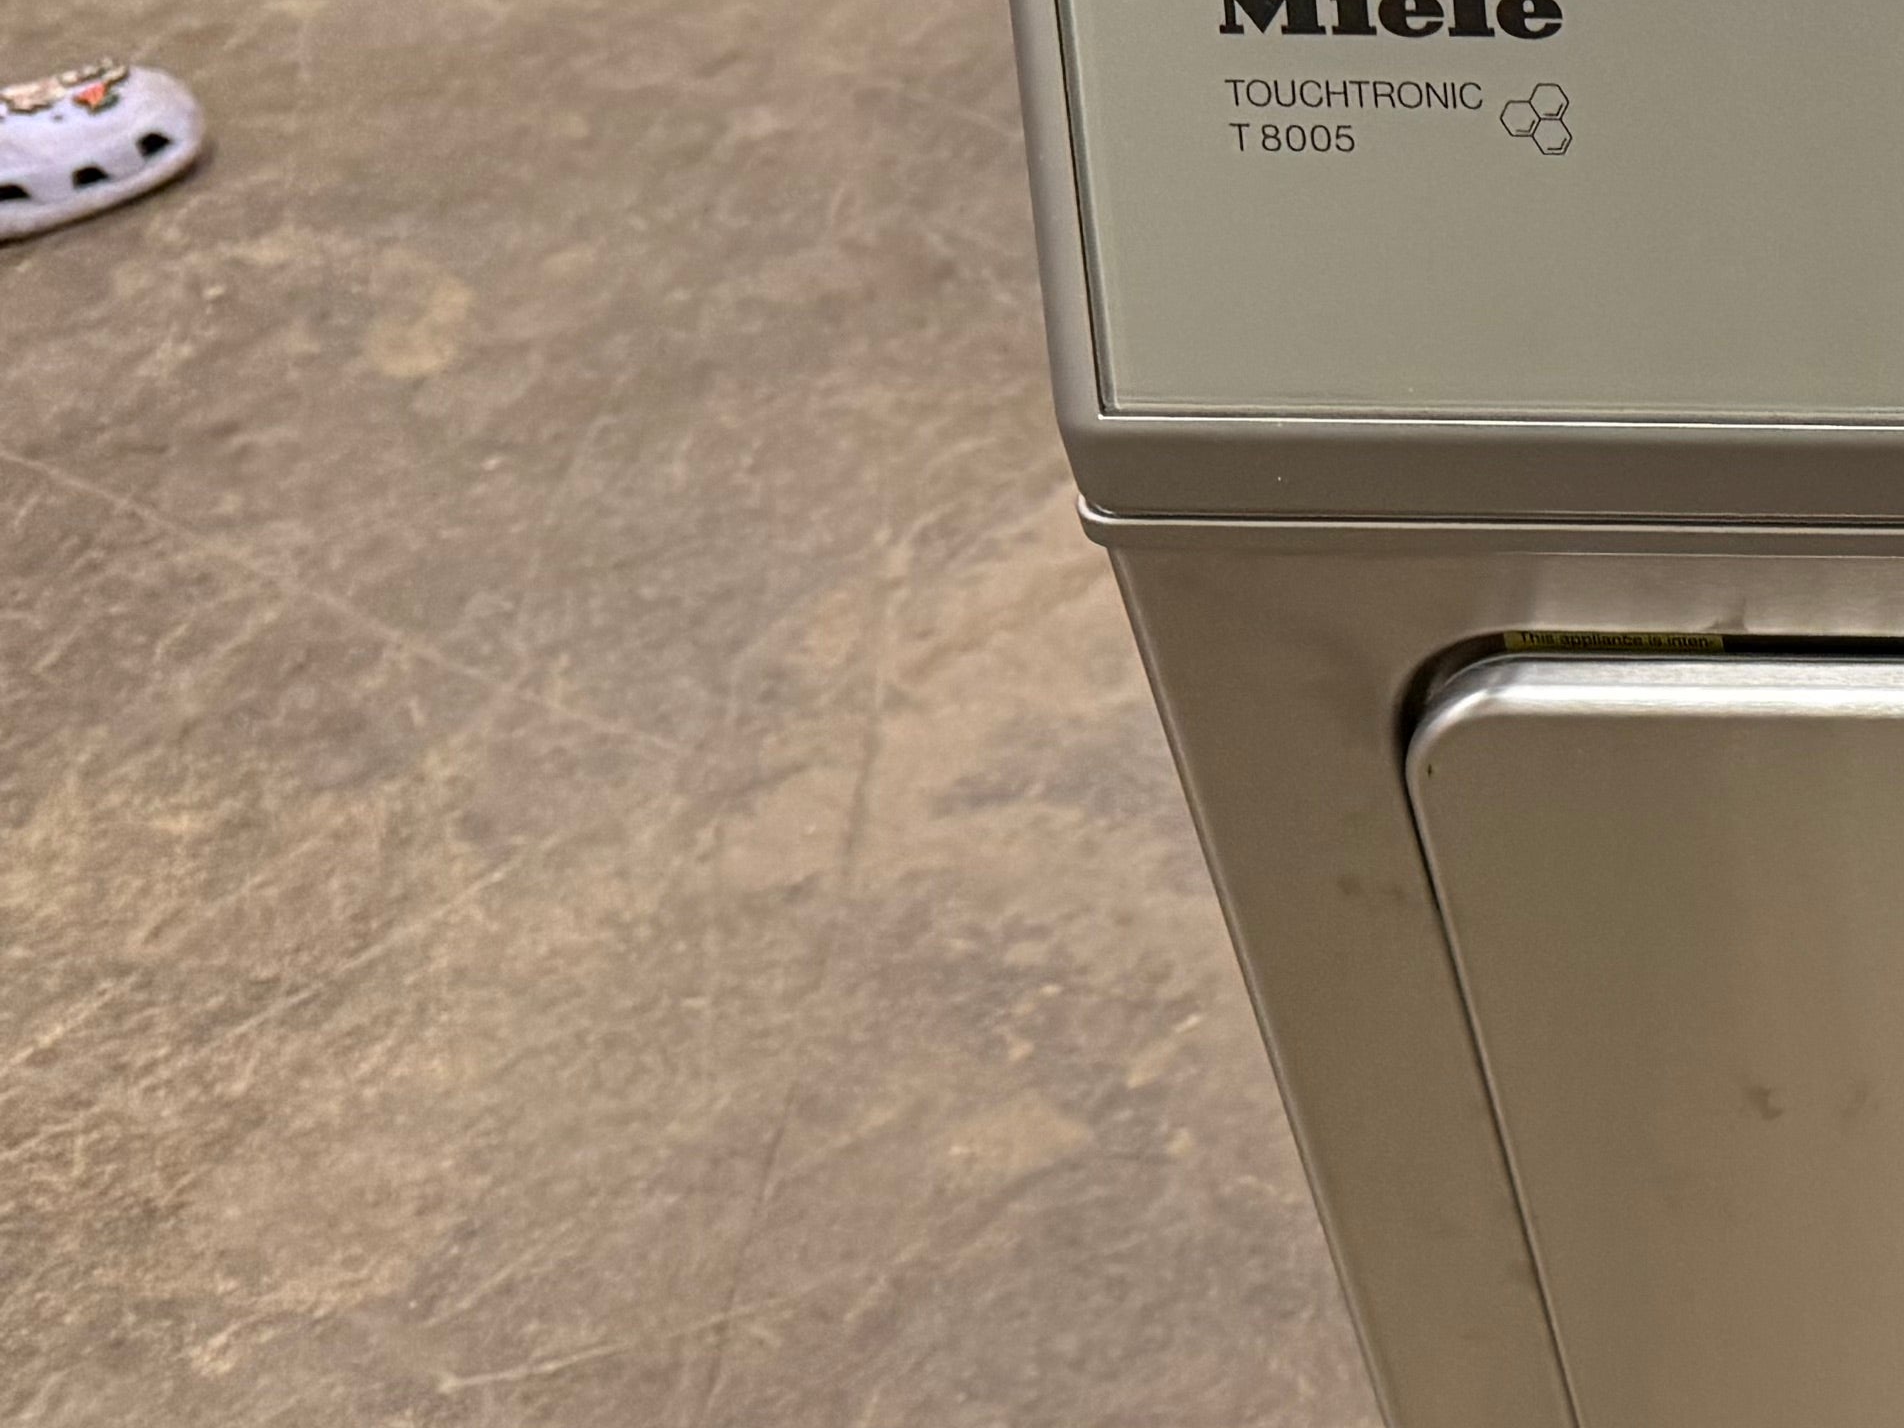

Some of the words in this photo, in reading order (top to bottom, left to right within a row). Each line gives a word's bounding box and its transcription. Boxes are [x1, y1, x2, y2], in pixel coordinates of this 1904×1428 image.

[1225, 80, 1482, 109] TOUCHTRONIC
[1229, 123, 1250, 151] T
[1262, 124, 1354, 152] 8005
